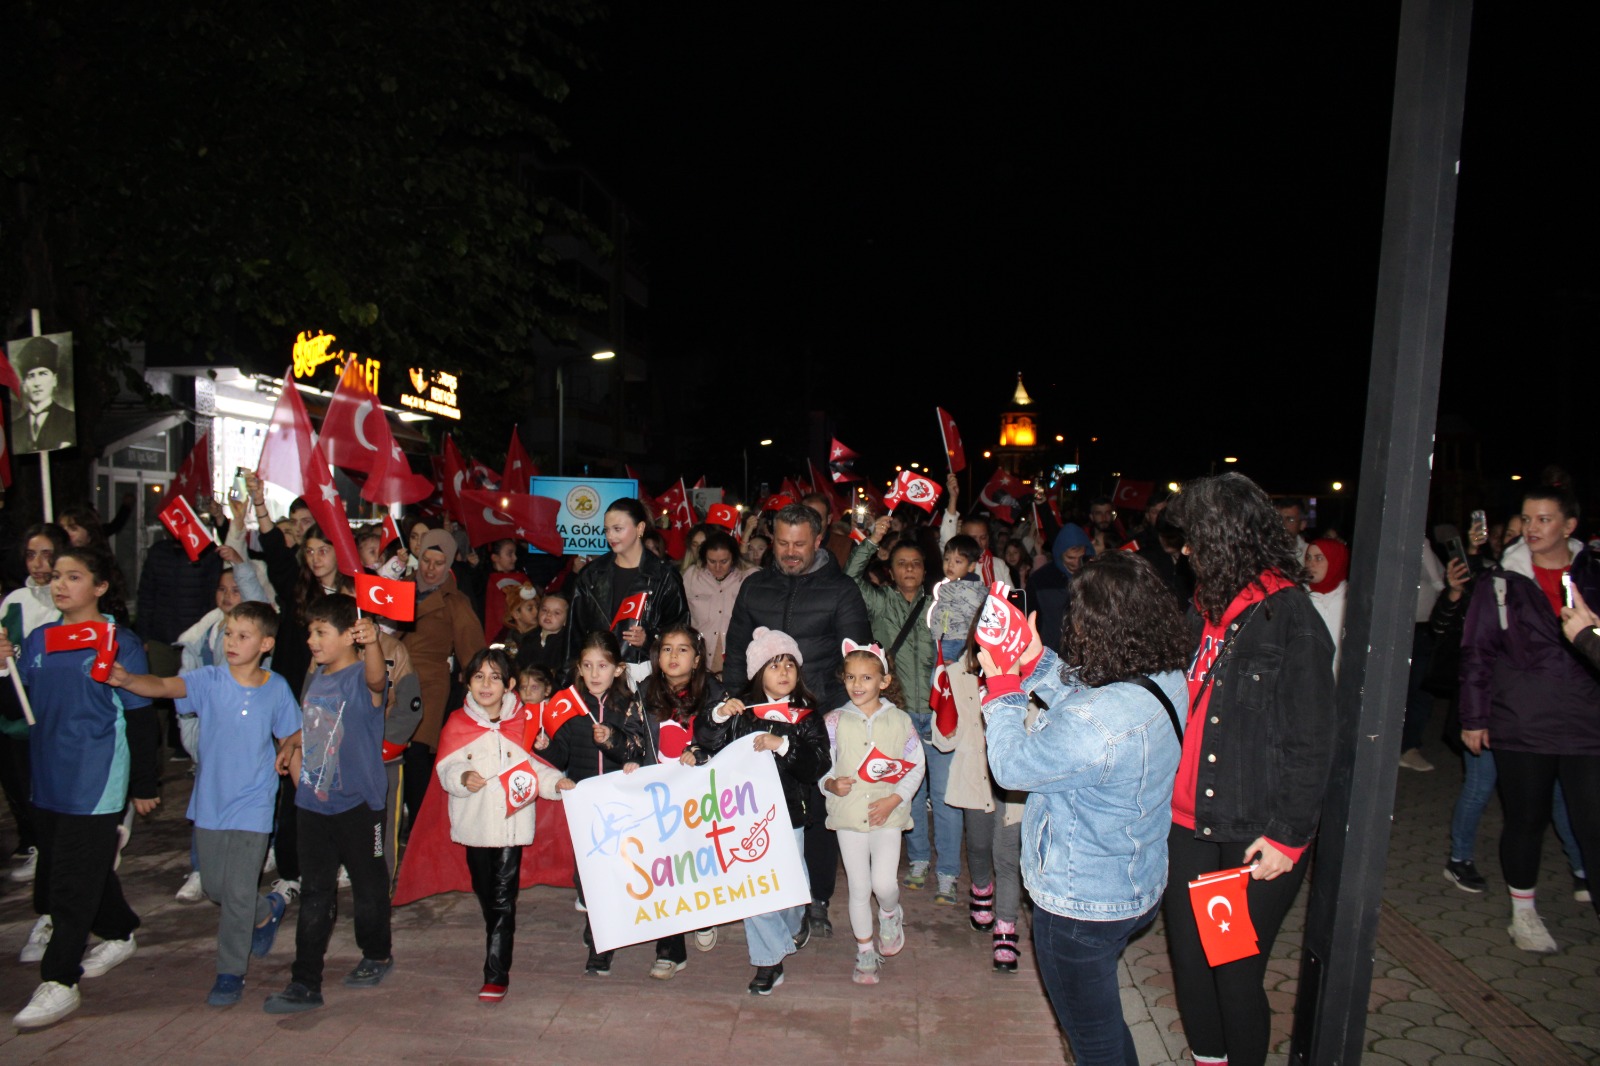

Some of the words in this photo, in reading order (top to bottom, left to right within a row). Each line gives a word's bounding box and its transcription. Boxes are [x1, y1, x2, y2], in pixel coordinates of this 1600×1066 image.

[893, 490, 904, 503] ATA
[1001, 630, 1015, 653] ATA
[1010, 641, 1025, 662] ATA
[644, 768, 759, 842] Beden
[620, 820, 736, 901] Sanat
[634, 868, 781, 925] AKADEMİSİ
